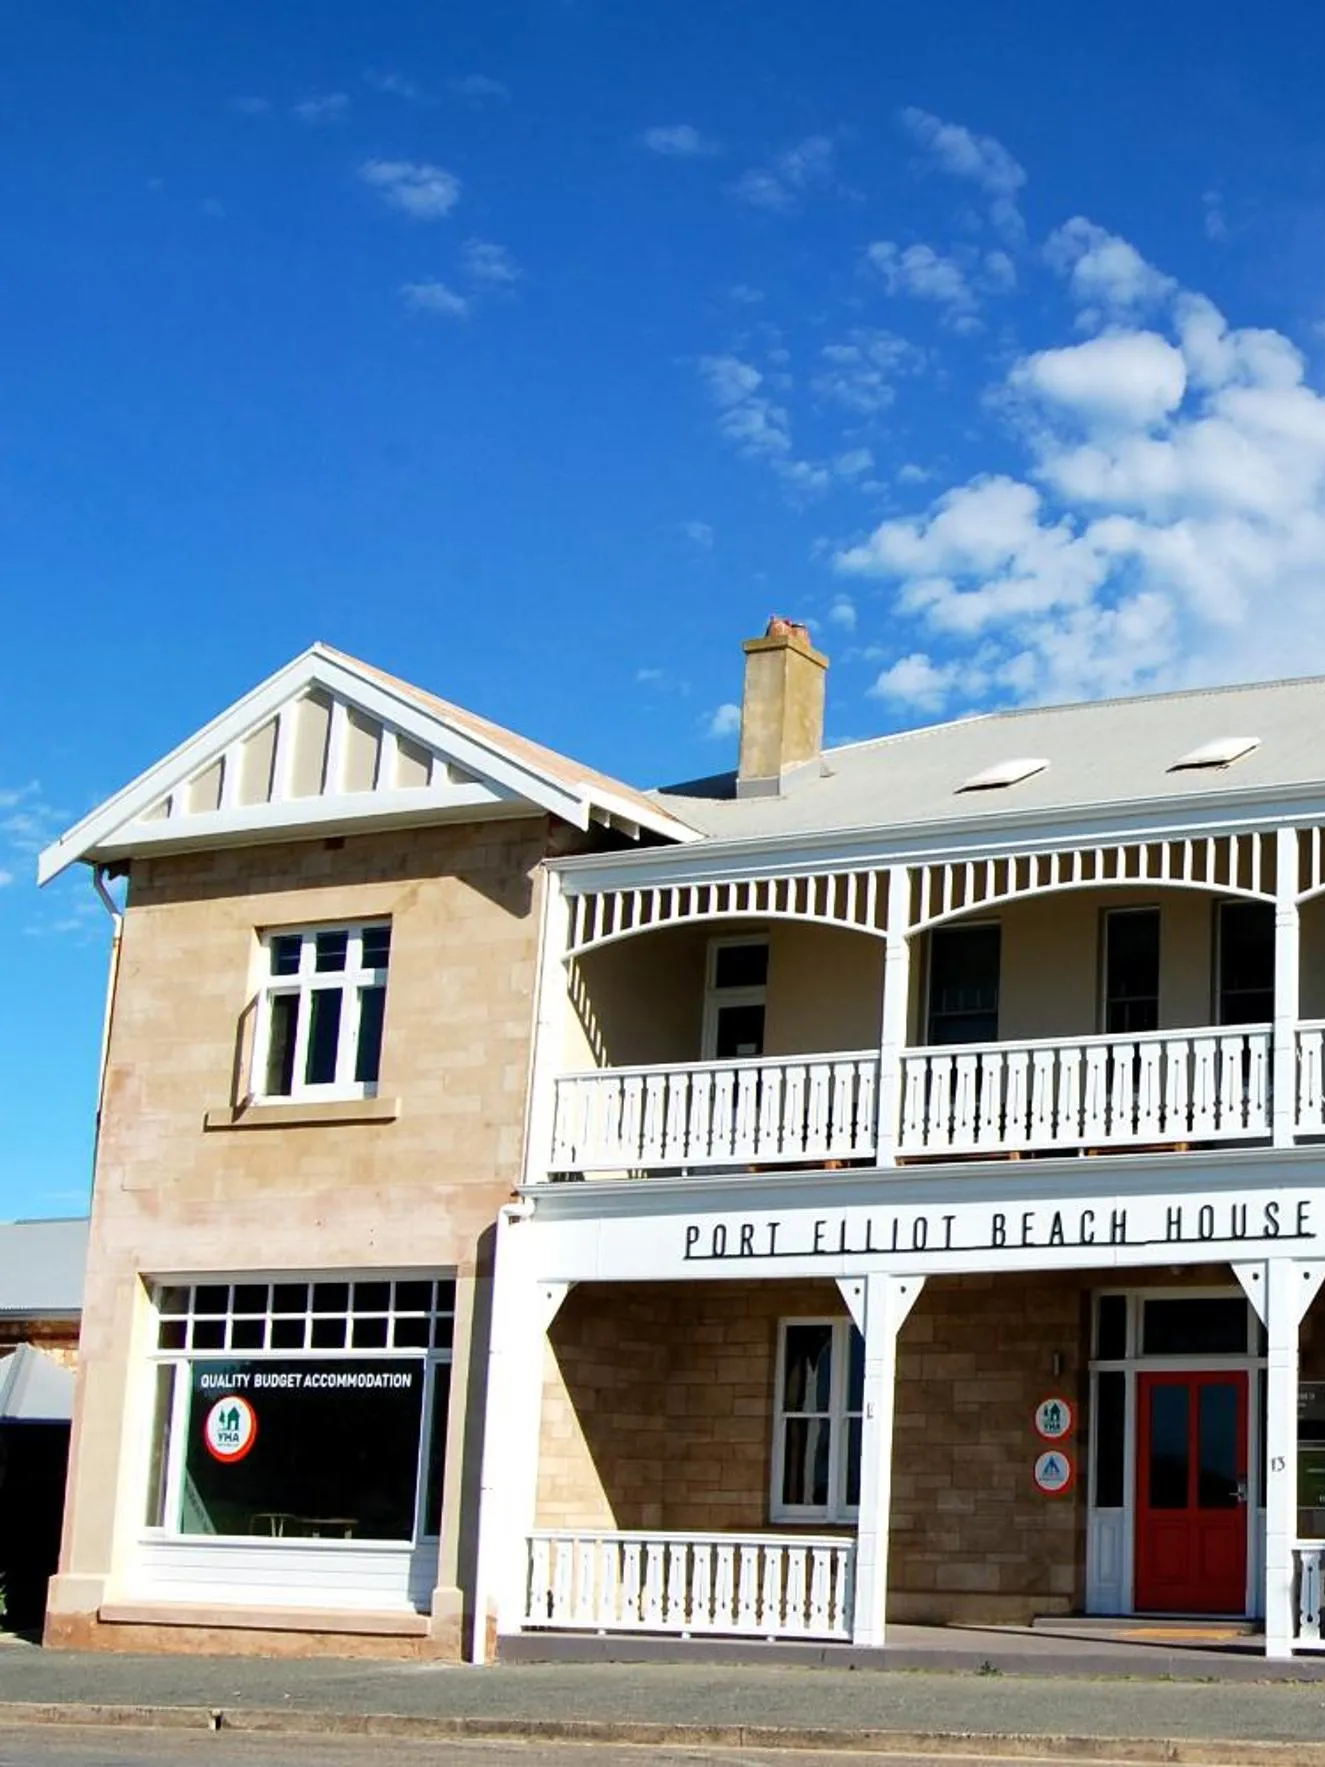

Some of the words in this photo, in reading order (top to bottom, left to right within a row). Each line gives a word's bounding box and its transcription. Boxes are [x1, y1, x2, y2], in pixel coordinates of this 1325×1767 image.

[686, 1221, 781, 1258] PORT
[813, 1215, 956, 1254] ELLIOT
[991, 1208, 1127, 1248] BEACH
[1166, 1200, 1313, 1242] HOUSE
[200, 1373, 250, 1388] QUALITY
[254, 1373, 302, 1388] BUDGET
[303, 1372, 412, 1388] ACCOMMODATION
[217, 1432, 240, 1442] YHA
[1271, 1455, 1286, 1472] 13
